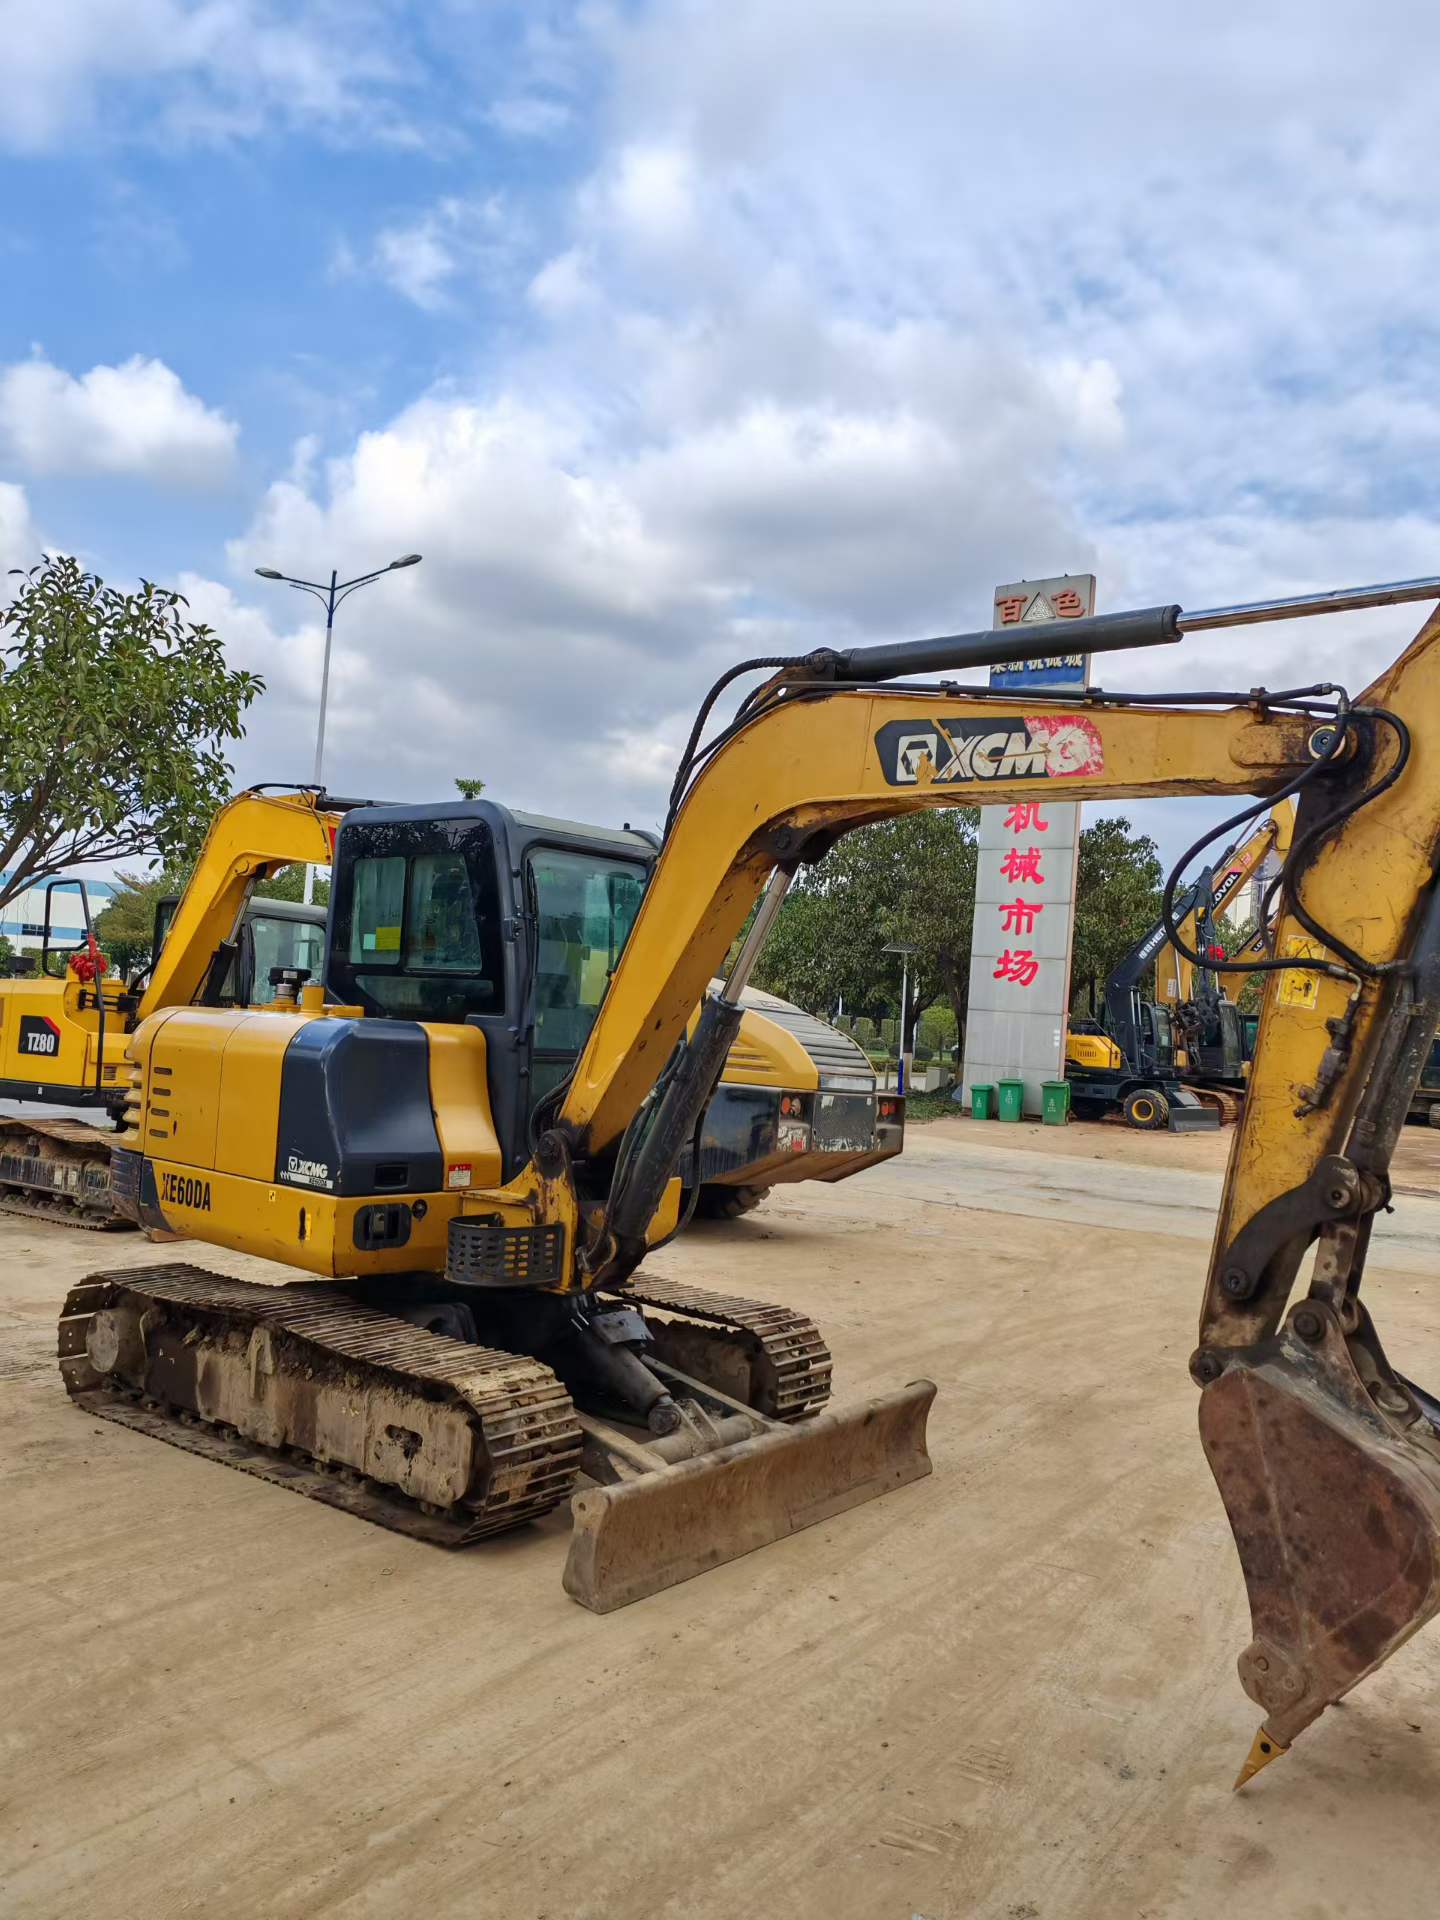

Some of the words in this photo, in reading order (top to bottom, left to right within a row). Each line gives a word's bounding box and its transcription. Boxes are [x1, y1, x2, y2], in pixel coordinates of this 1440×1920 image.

[1212, 873, 1239, 906] OVOL
[27, 1032, 55, 1053] TZ80
[298, 1159, 329, 1179] XCMG
[160, 1172, 212, 1212] XE60DA
